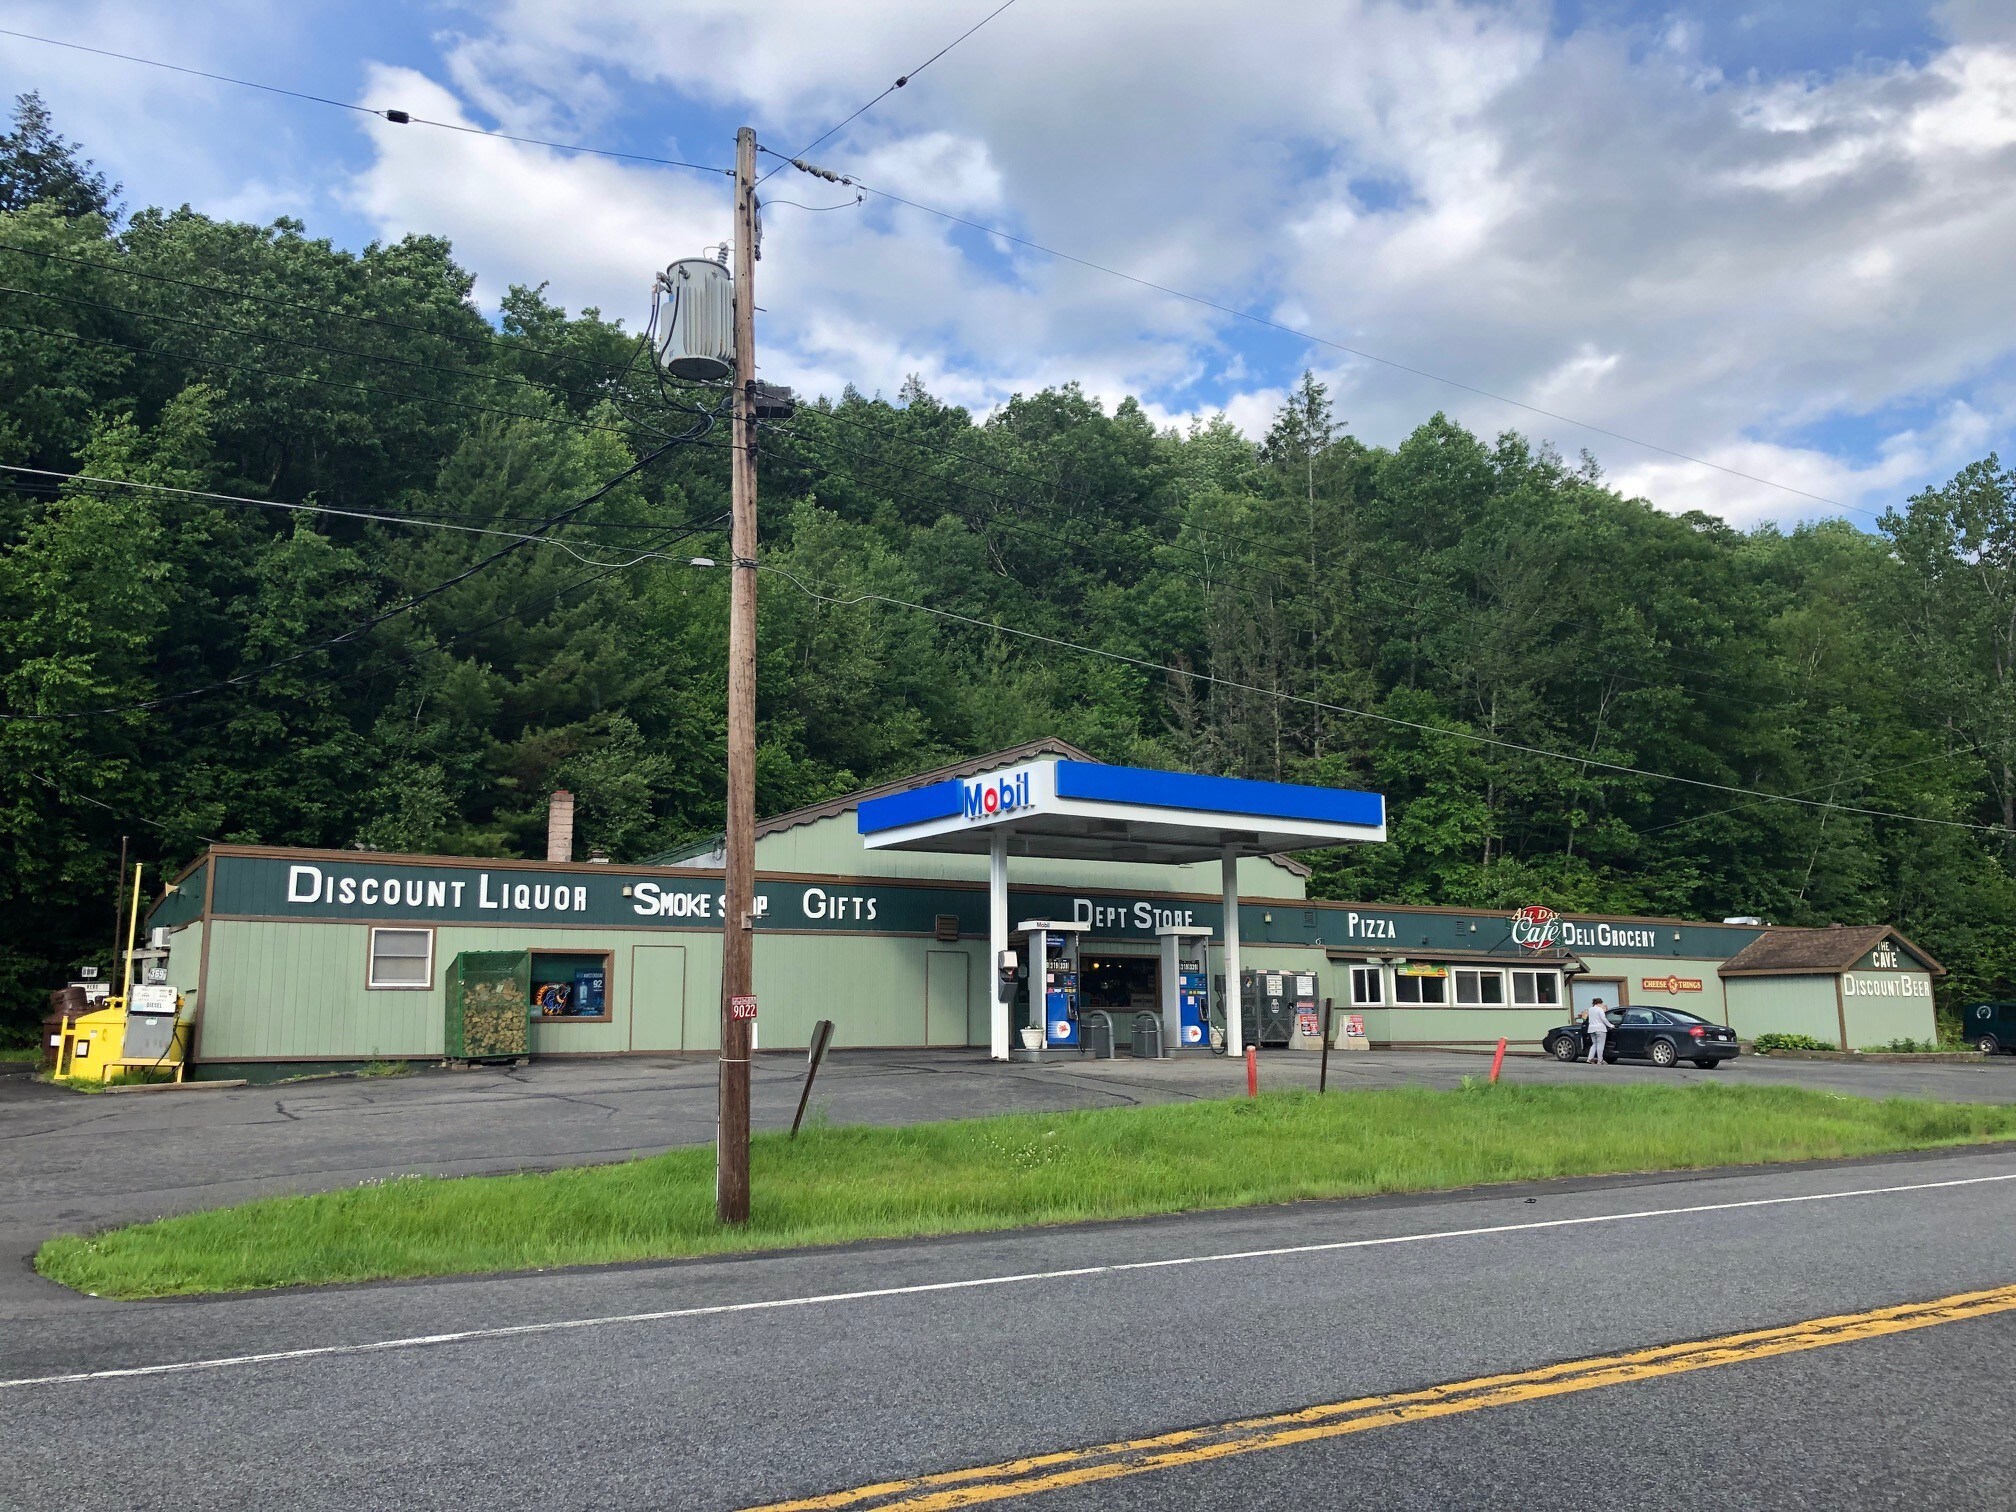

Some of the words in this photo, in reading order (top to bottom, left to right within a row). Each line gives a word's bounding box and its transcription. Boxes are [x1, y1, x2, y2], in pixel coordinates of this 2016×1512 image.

[964, 771, 1029, 818] Mobil
[287, 865, 466, 908] DISCOUNT
[479, 873, 587, 911] LIQUOR
[633, 882, 711, 918] SMOKE
[802, 887, 877, 920] GIFTS
[1073, 898, 1127, 928] DEPT
[1133, 901, 1193, 929] STORE
[1511, 907, 1534, 920] ALL
[1537, 909, 1561, 921] DAY
[1348, 912, 1396, 939] PIZZA
[1562, 922, 1595, 946] DELI
[1597, 923, 1656, 948] GROCERY
[1876, 941, 1890, 951] THE
[1872, 951, 1898, 968] CAVE
[1678, 981, 1701, 989] THINGS
[1843, 973, 1900, 997] DISCOUNT
[1900, 974, 1931, 997] BEER
[146, 1001, 163, 1009] DIESEL
[733, 1004, 756, 1018] 9022
